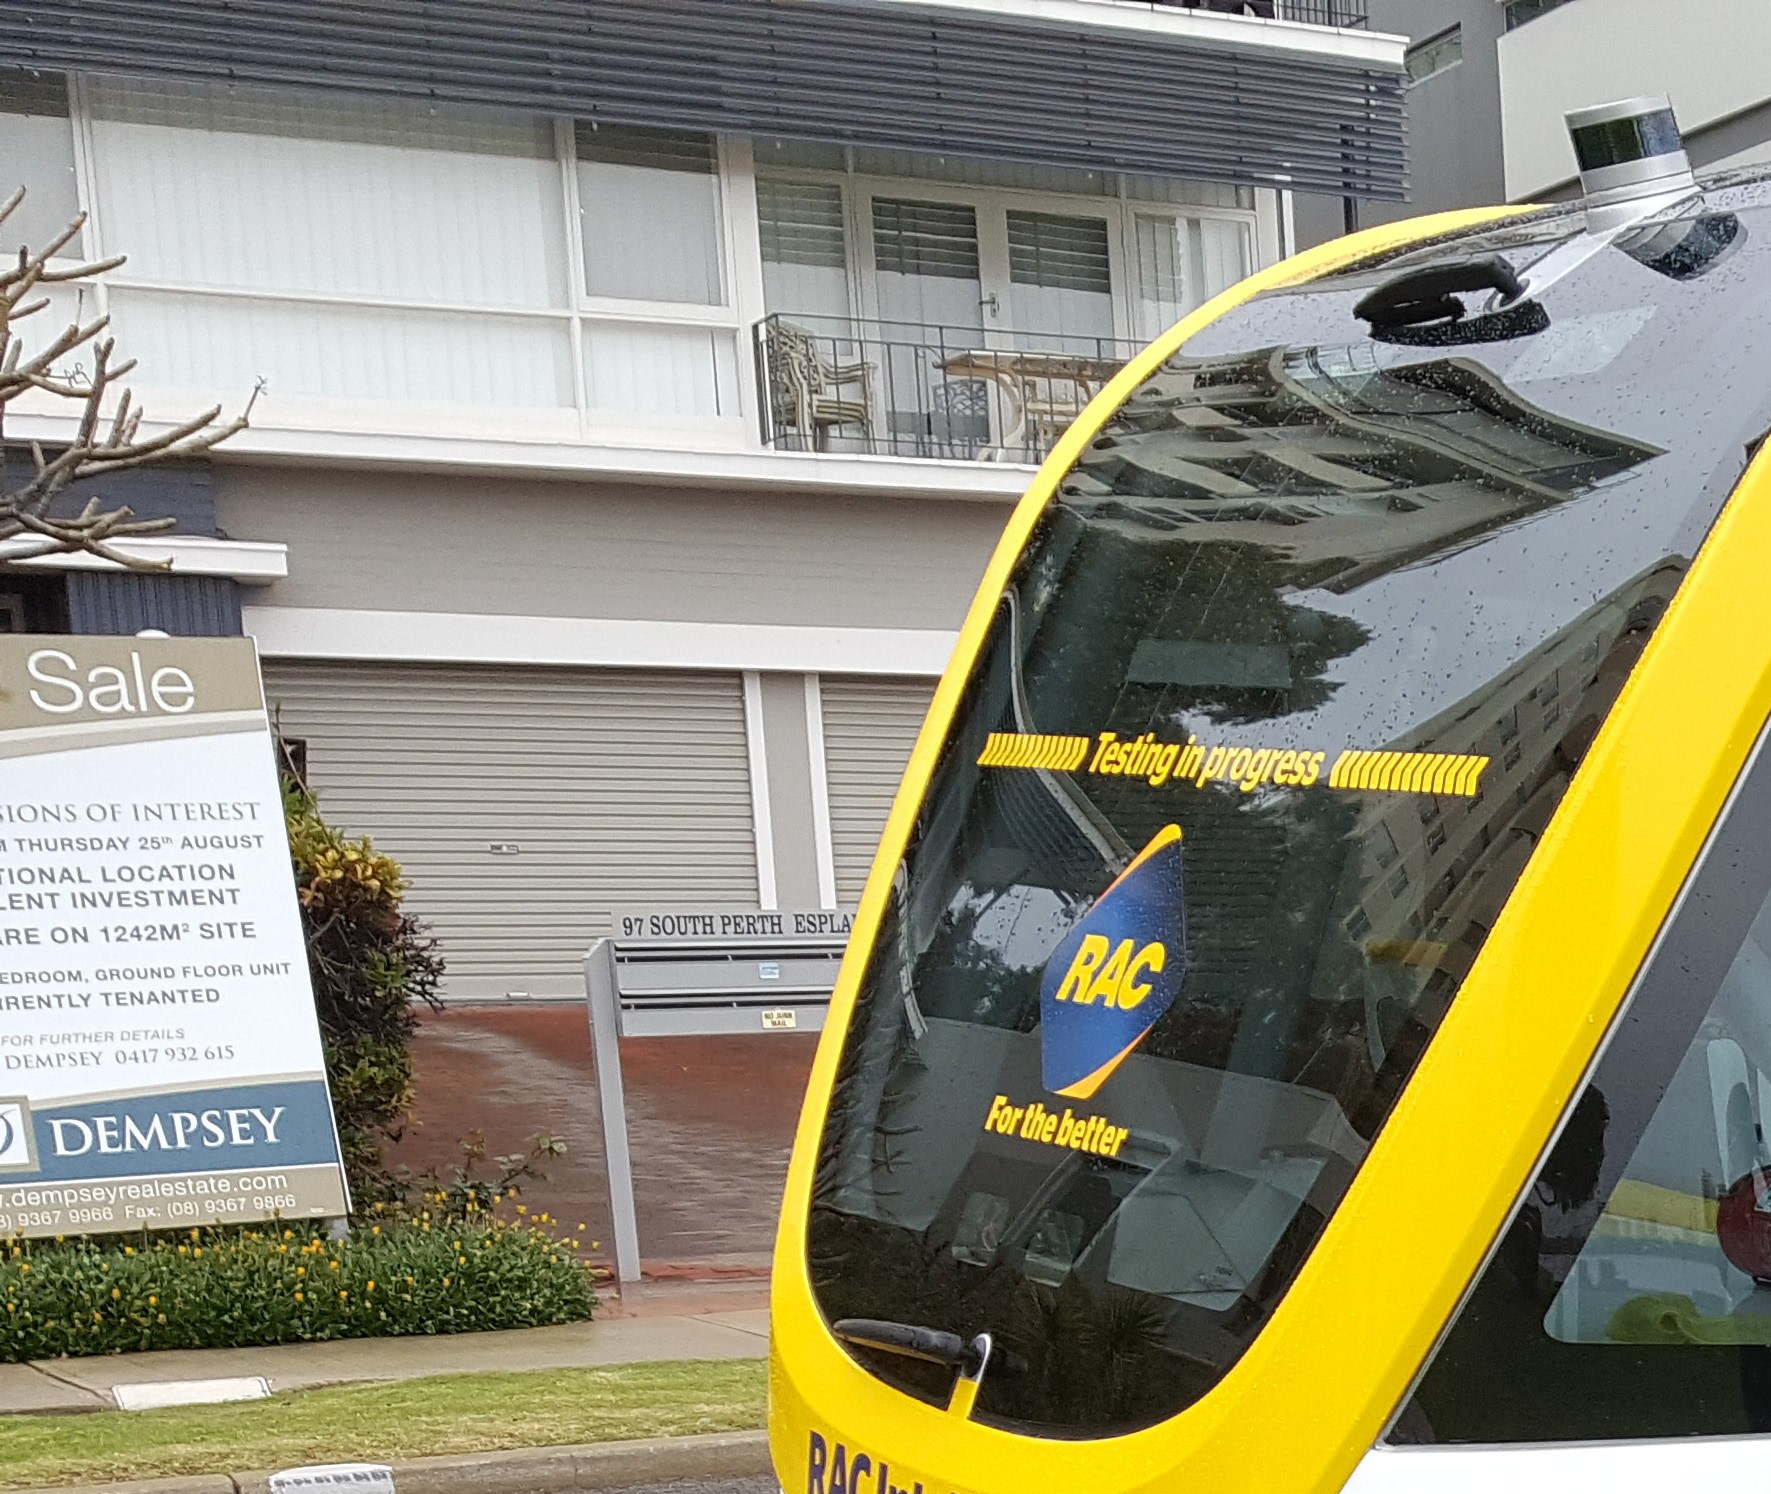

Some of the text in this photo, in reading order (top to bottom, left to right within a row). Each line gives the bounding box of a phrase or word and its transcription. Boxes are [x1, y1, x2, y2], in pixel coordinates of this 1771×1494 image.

[27, 650, 195, 712] Sale
[1088, 732, 1326, 792] Testing in progress
[0, 802, 261, 823] IONS OF INTEREST
[14, 836, 130, 852] THURSDAY
[139, 835, 173, 850] 25th
[181, 835, 264, 850] AUGUST
[100, 863, 235, 883] LOCATION
[71, 888, 240, 909] INVESTMENT
[50, 926, 90, 944] ON
[199, 921, 257, 940] SITE
[622, 913, 857, 937] 97 SOUTH PERTH ESPLA
[95, 966, 176, 982] GROUND
[182, 964, 243, 979] FLOOR
[249, 963, 291, 976] UNIT
[1055, 934, 1166, 1010] RAC
[0, 988, 220, 1011] RENTLY TENANTED
[1, 1028, 185, 1047] FOR FURTHER DETAILS
[5, 1044, 235, 1070] DEMPSEY 0417 932 615
[45, 1105, 288, 1157] DEMPSEY
[984, 1095, 1129, 1157] For the better
[18, 1210, 61, 1226] 9367
[68, 1207, 114, 1223] 9966
[125, 1204, 161, 1219] Fax:
[167, 1202, 199, 1218] (08)
[204, 1197, 246, 1213] 9367
[252, 1194, 296, 1210] 9866
